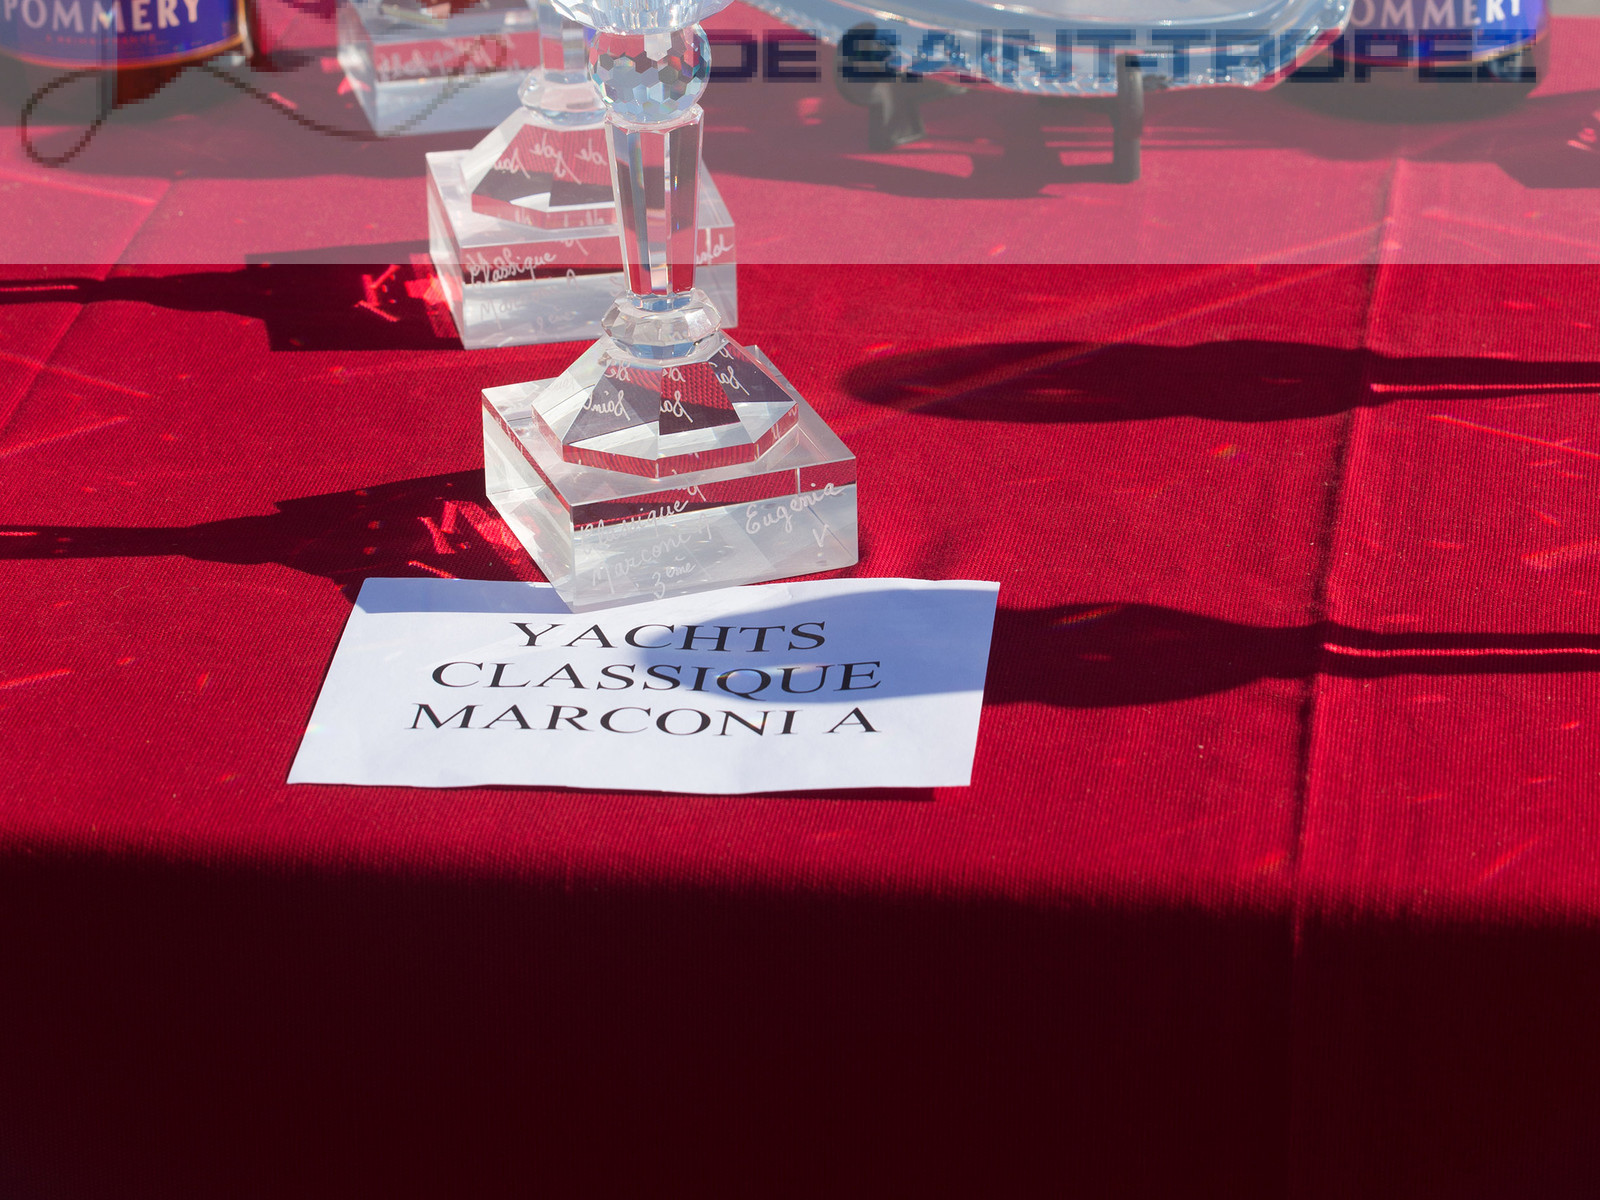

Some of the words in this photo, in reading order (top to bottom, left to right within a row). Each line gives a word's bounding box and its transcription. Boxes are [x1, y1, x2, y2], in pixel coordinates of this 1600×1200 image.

[746, 481, 846, 535] Eugenia
[512, 620, 827, 653] YACHTS
[431, 659, 882, 698] CLASSIQUE
[410, 702, 798, 737] MARCONI
[825, 707, 881, 734] A
